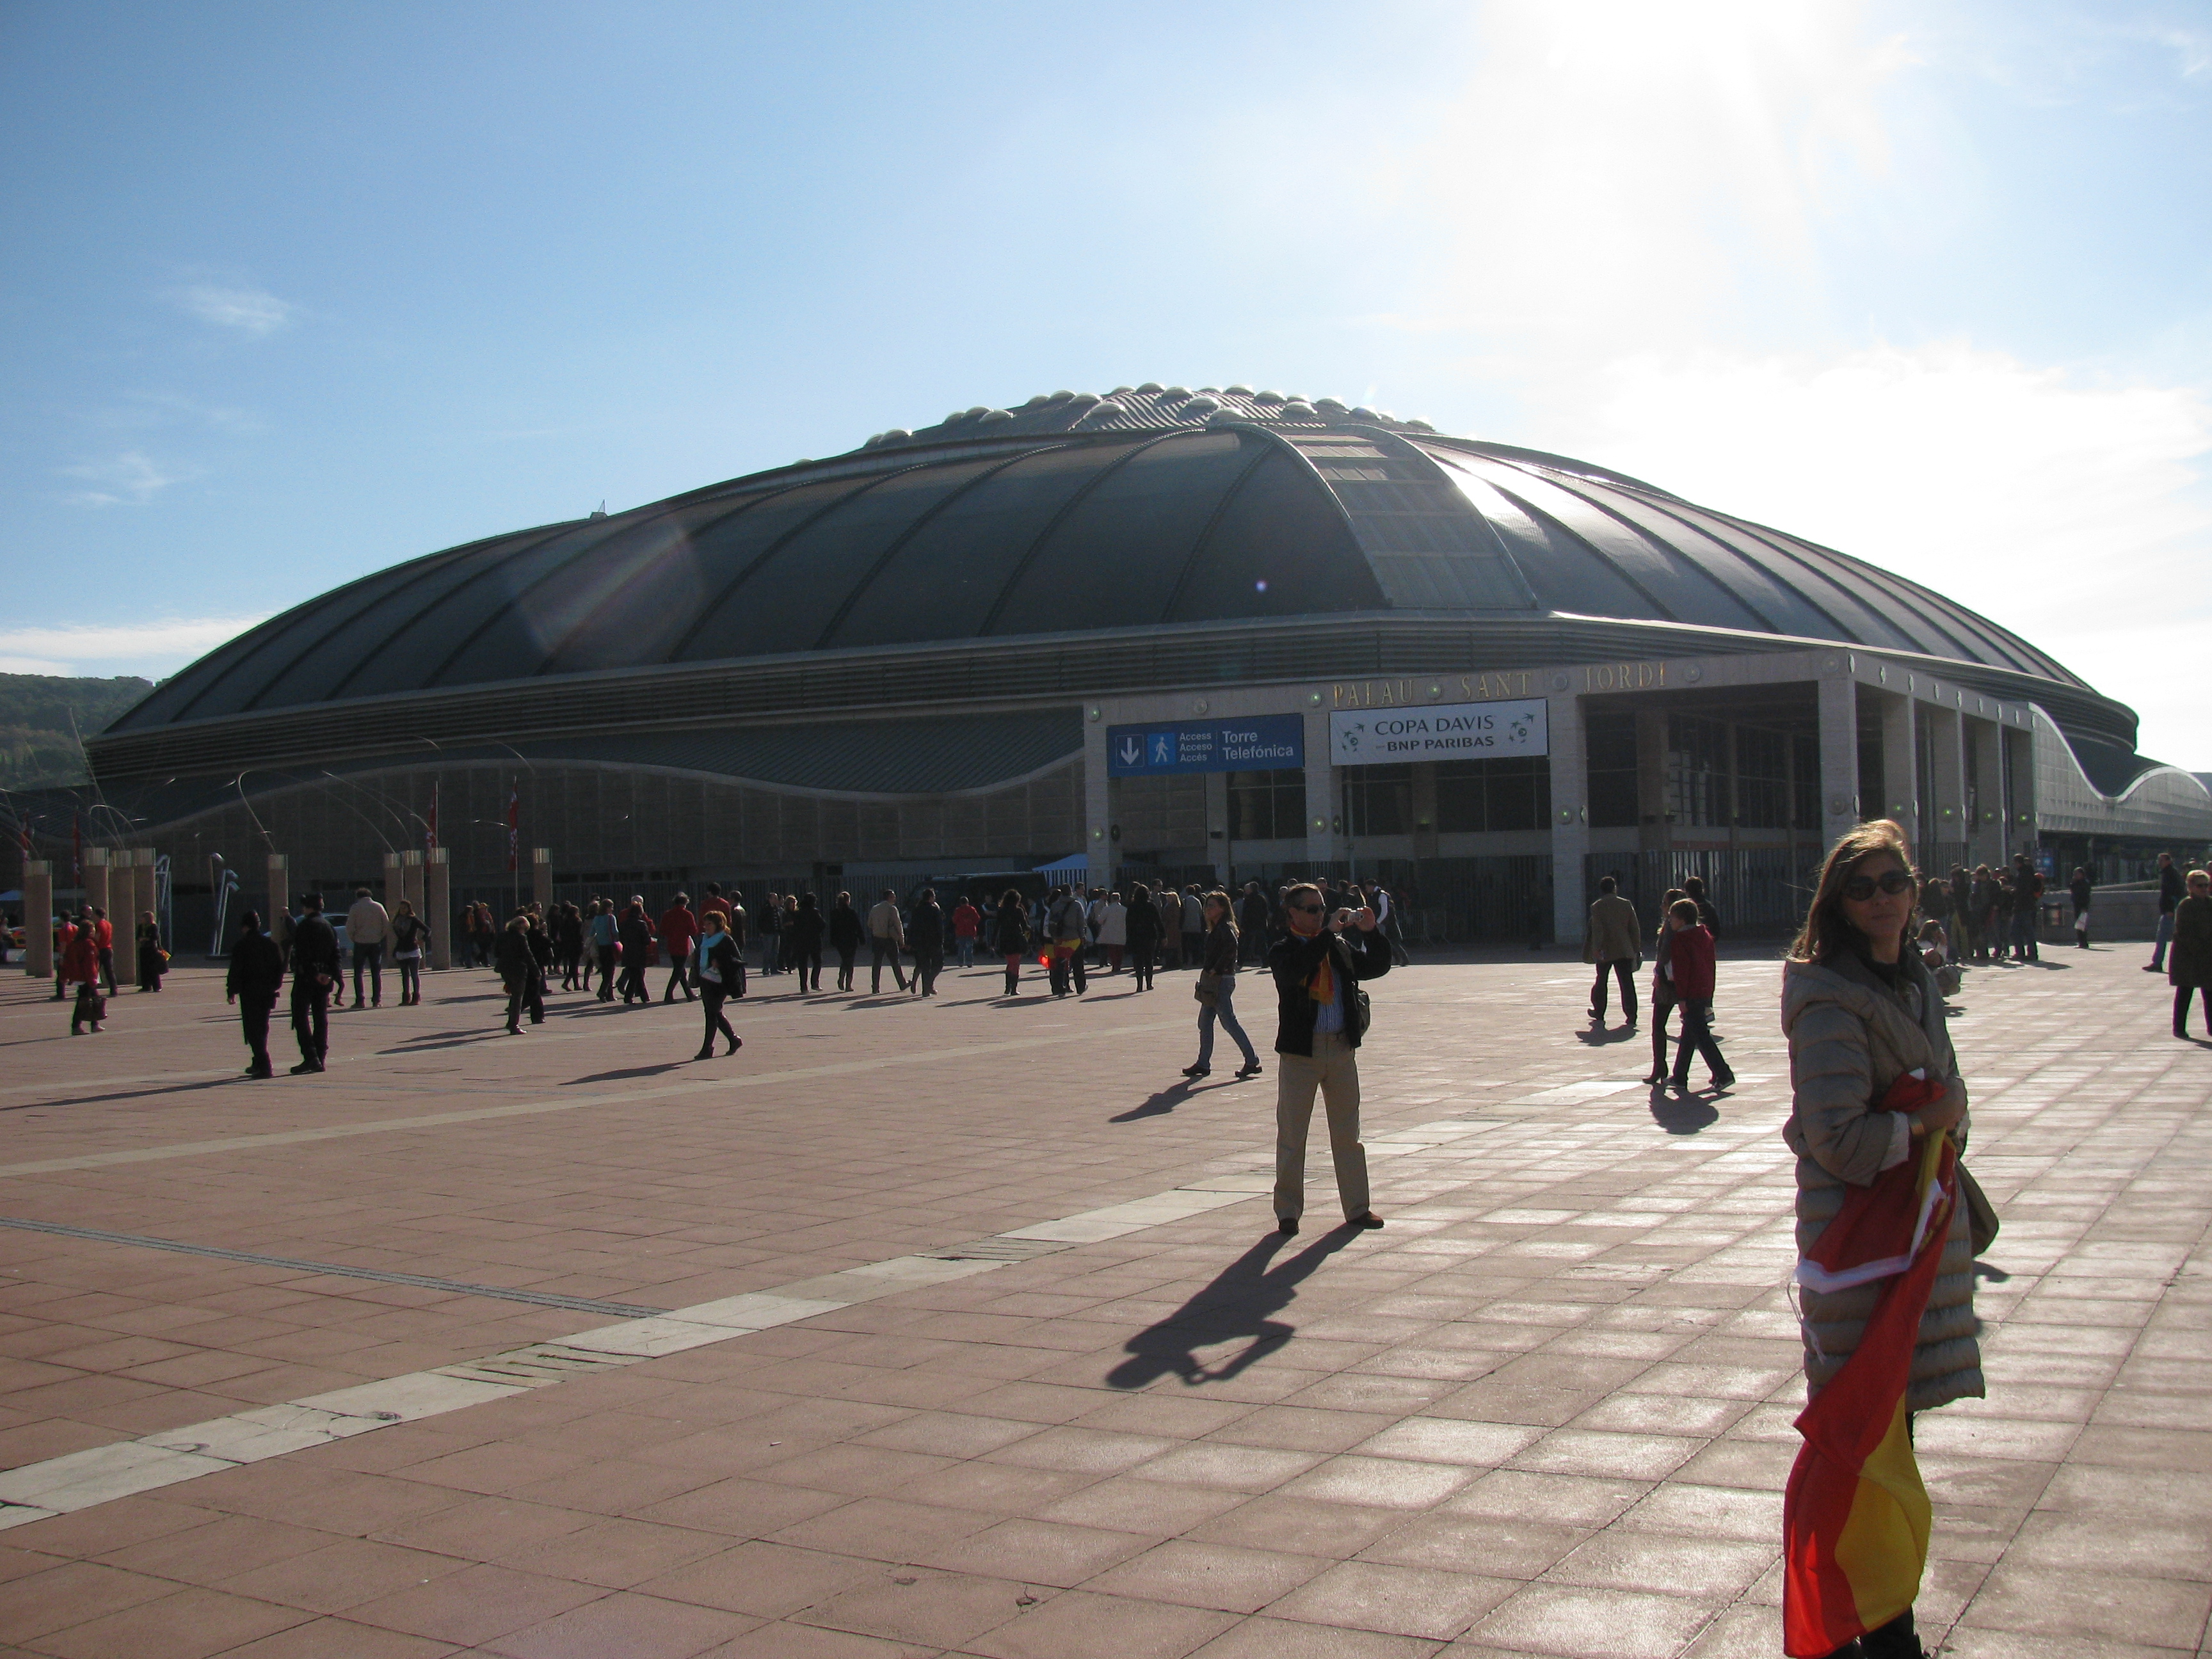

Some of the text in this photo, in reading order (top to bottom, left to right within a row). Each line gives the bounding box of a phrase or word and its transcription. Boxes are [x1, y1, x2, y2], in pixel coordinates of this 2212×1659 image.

[1333, 662, 1666, 707] PALAU SANT JORDI
[1375, 715, 1494, 735] COPA DAVIS
[1179, 732, 1212, 741] Access
[1222, 731, 1258, 744] Torre
[1388, 735, 1494, 751] BNP PARIBAS
[1179, 743, 1212, 751] Acceso
[1222, 744, 1294, 760] Telefónica
[1180, 753, 1208, 762] Accés
